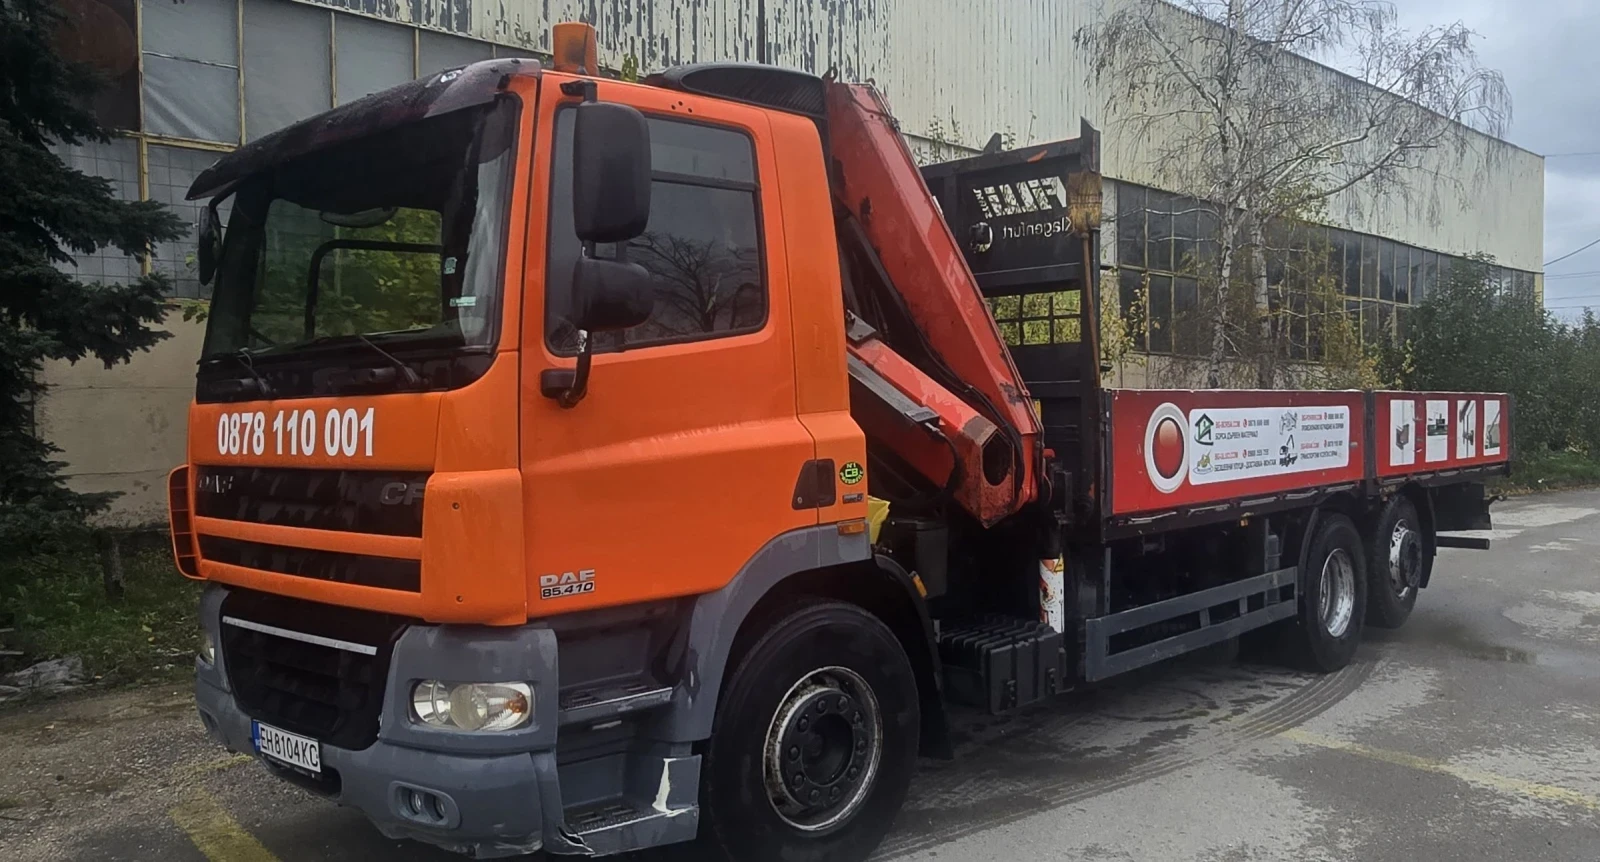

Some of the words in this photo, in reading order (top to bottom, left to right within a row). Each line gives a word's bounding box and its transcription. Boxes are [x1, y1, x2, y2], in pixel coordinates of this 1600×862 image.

[218, 411, 265, 455] 0878
[272, 409, 316, 456] 110
[324, 407, 374, 457] 001
[844, 467, 859, 478] CB
[381, 482, 425, 505] CF
[540, 569, 596, 587] DAF
[542, 582, 594, 598] 85.410
